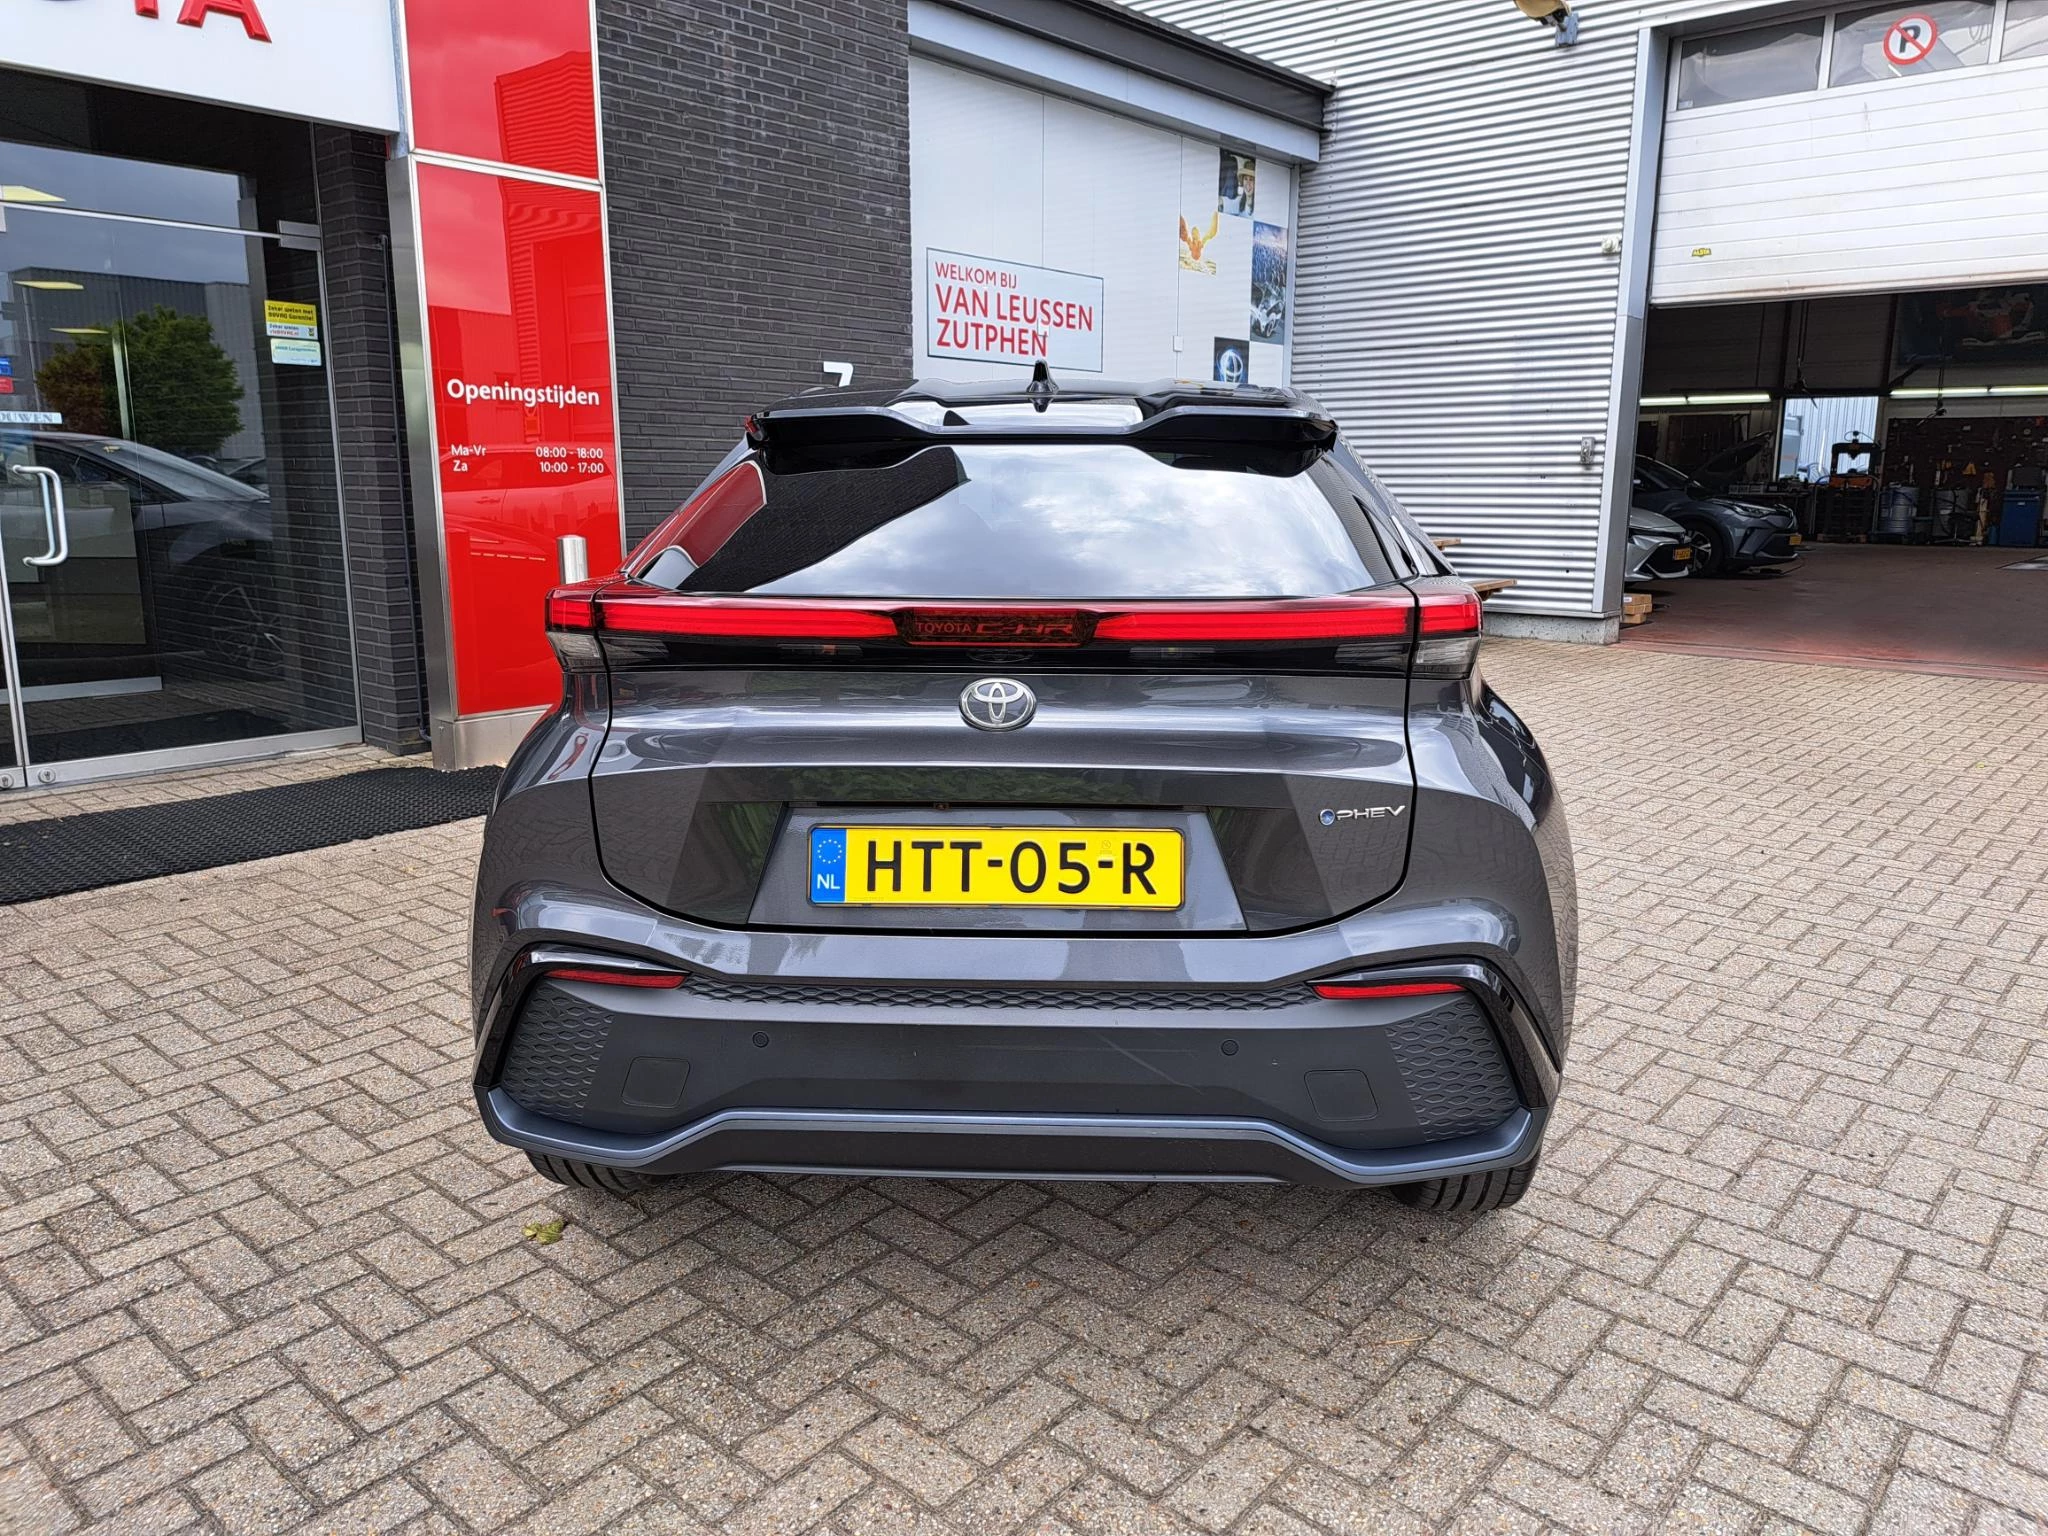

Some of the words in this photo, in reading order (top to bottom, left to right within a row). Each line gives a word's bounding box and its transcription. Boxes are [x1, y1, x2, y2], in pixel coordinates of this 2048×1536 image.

[935, 261, 997, 286] WELKOM
[1000, 272, 1017, 289] BIJ
[935, 283, 988, 318] VAN
[996, 292, 1093, 332] LEUSSEN
[936, 318, 1047, 357] ZUTPHEN
[446, 378, 600, 409] Openingstijden
[451, 444, 487, 456] Ma-Vr
[535, 446, 567, 458] 08:00
[576, 447, 603, 459] 18:00
[453, 459, 468, 472] Za
[540, 461, 568, 473] 10:00
[578, 462, 604, 473] 17:00
[916, 622, 972, 634] TOYOTA
[975, 623, 1073, 634] C-HR
[1336, 805, 1406, 821] PHEV
[866, 840, 1157, 895] HTT-05-R
[816, 873, 841, 890] NL
